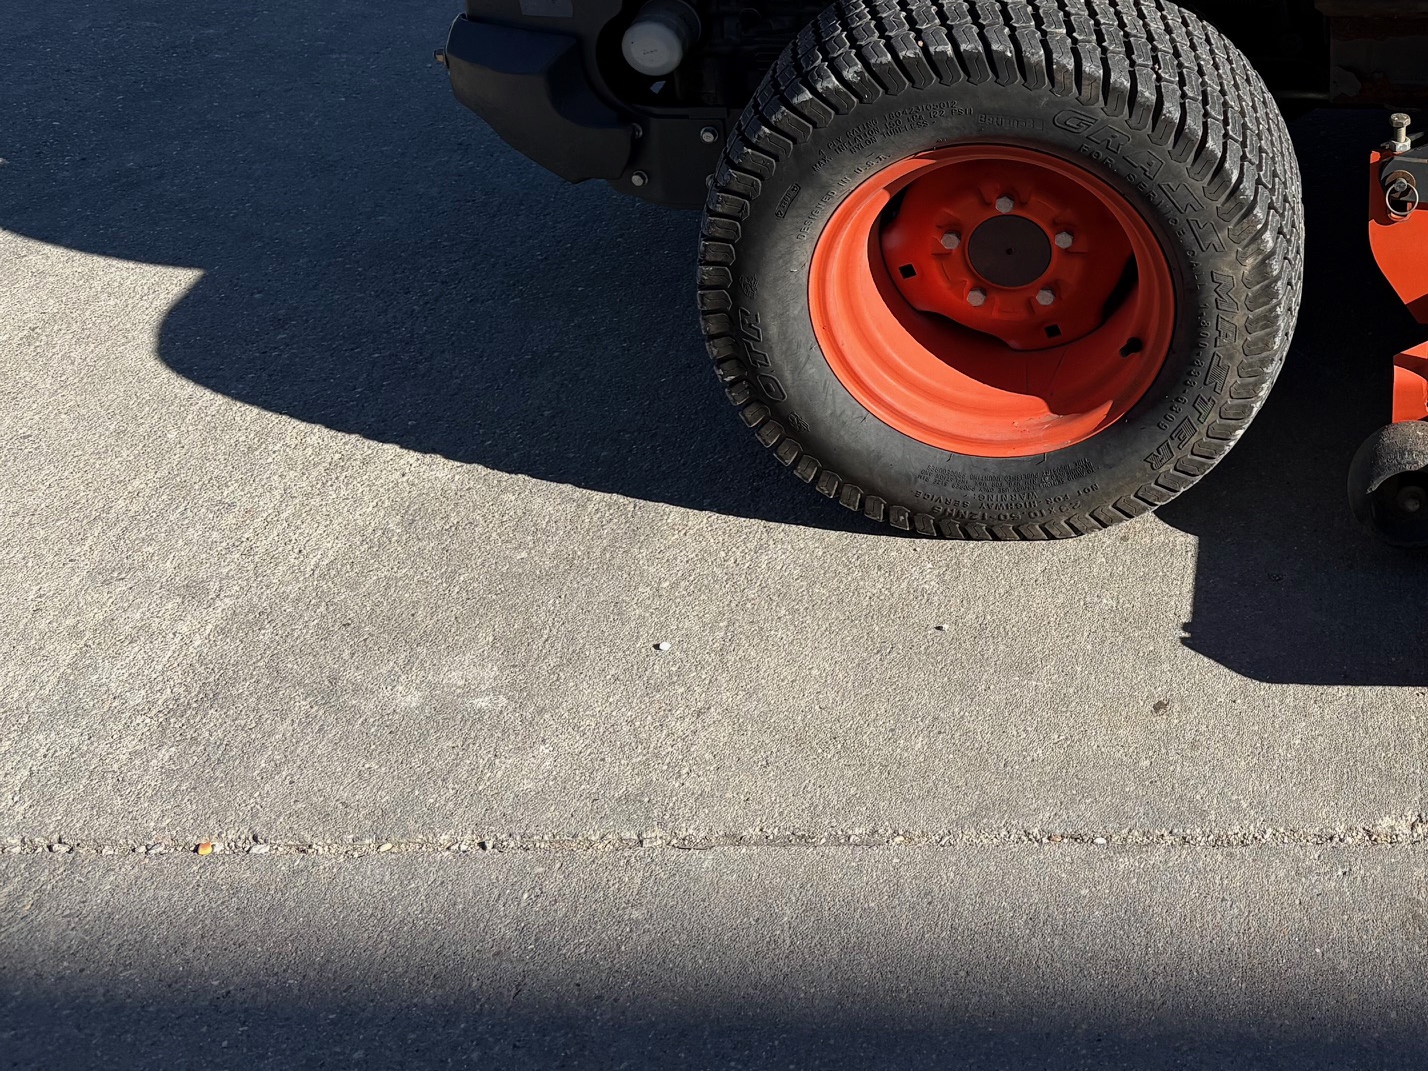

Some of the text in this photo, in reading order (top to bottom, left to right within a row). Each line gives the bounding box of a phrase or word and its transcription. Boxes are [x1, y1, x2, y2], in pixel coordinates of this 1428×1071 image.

[1053, 109, 1226, 253] GRASS
[796, 188, 837, 242] DESIGNED
[914, 489, 971, 508] SERVICE
